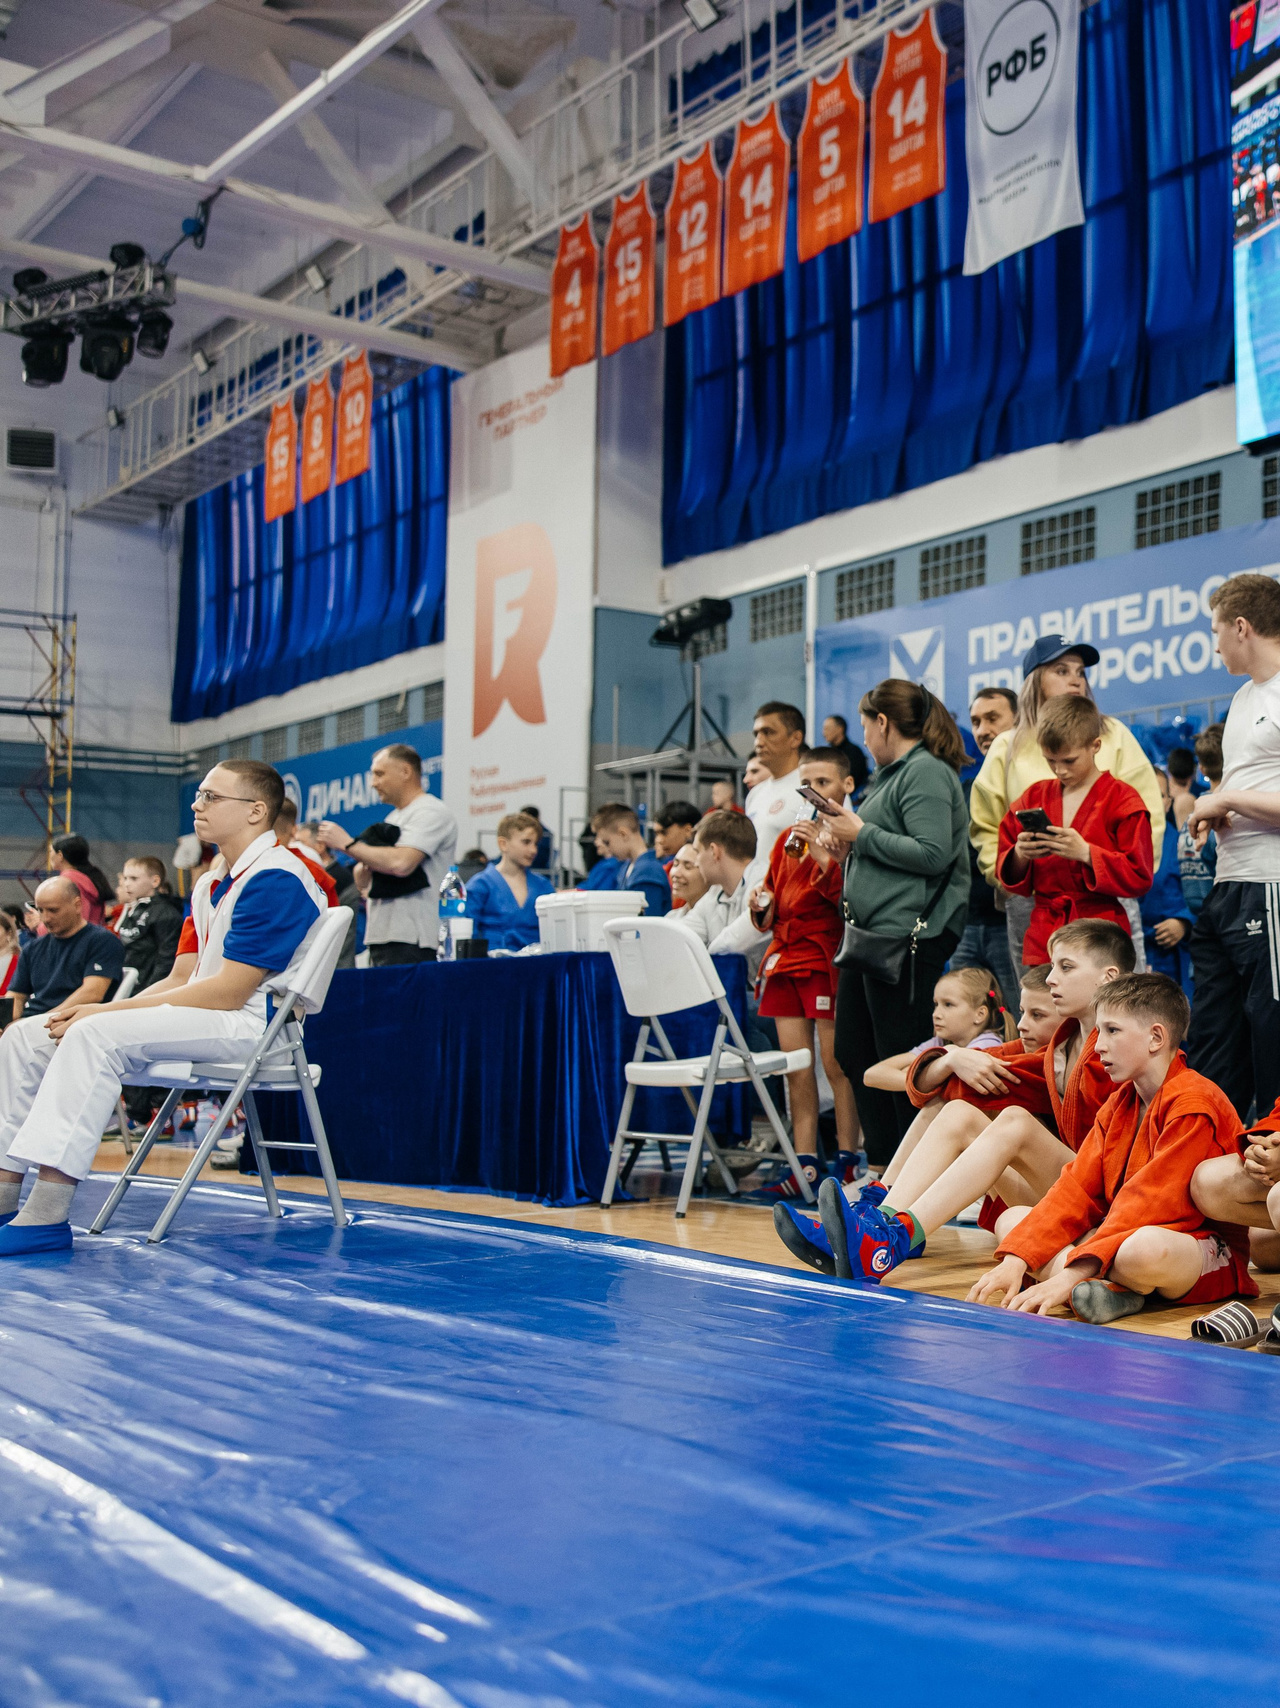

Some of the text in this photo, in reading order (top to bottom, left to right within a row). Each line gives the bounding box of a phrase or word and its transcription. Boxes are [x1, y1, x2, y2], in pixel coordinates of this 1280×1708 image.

[987, 32, 1047, 98] РФБ
[887, 75, 928, 139] 14
[819, 125, 841, 179] 5
[739, 163, 774, 220] 14
[677, 201, 709, 253] 12
[615, 236, 643, 286] 15
[565, 268, 582, 308] 4
[311, 414, 324, 450] 8
[345, 390, 366, 430] 10
[272, 434, 290, 471] 15
